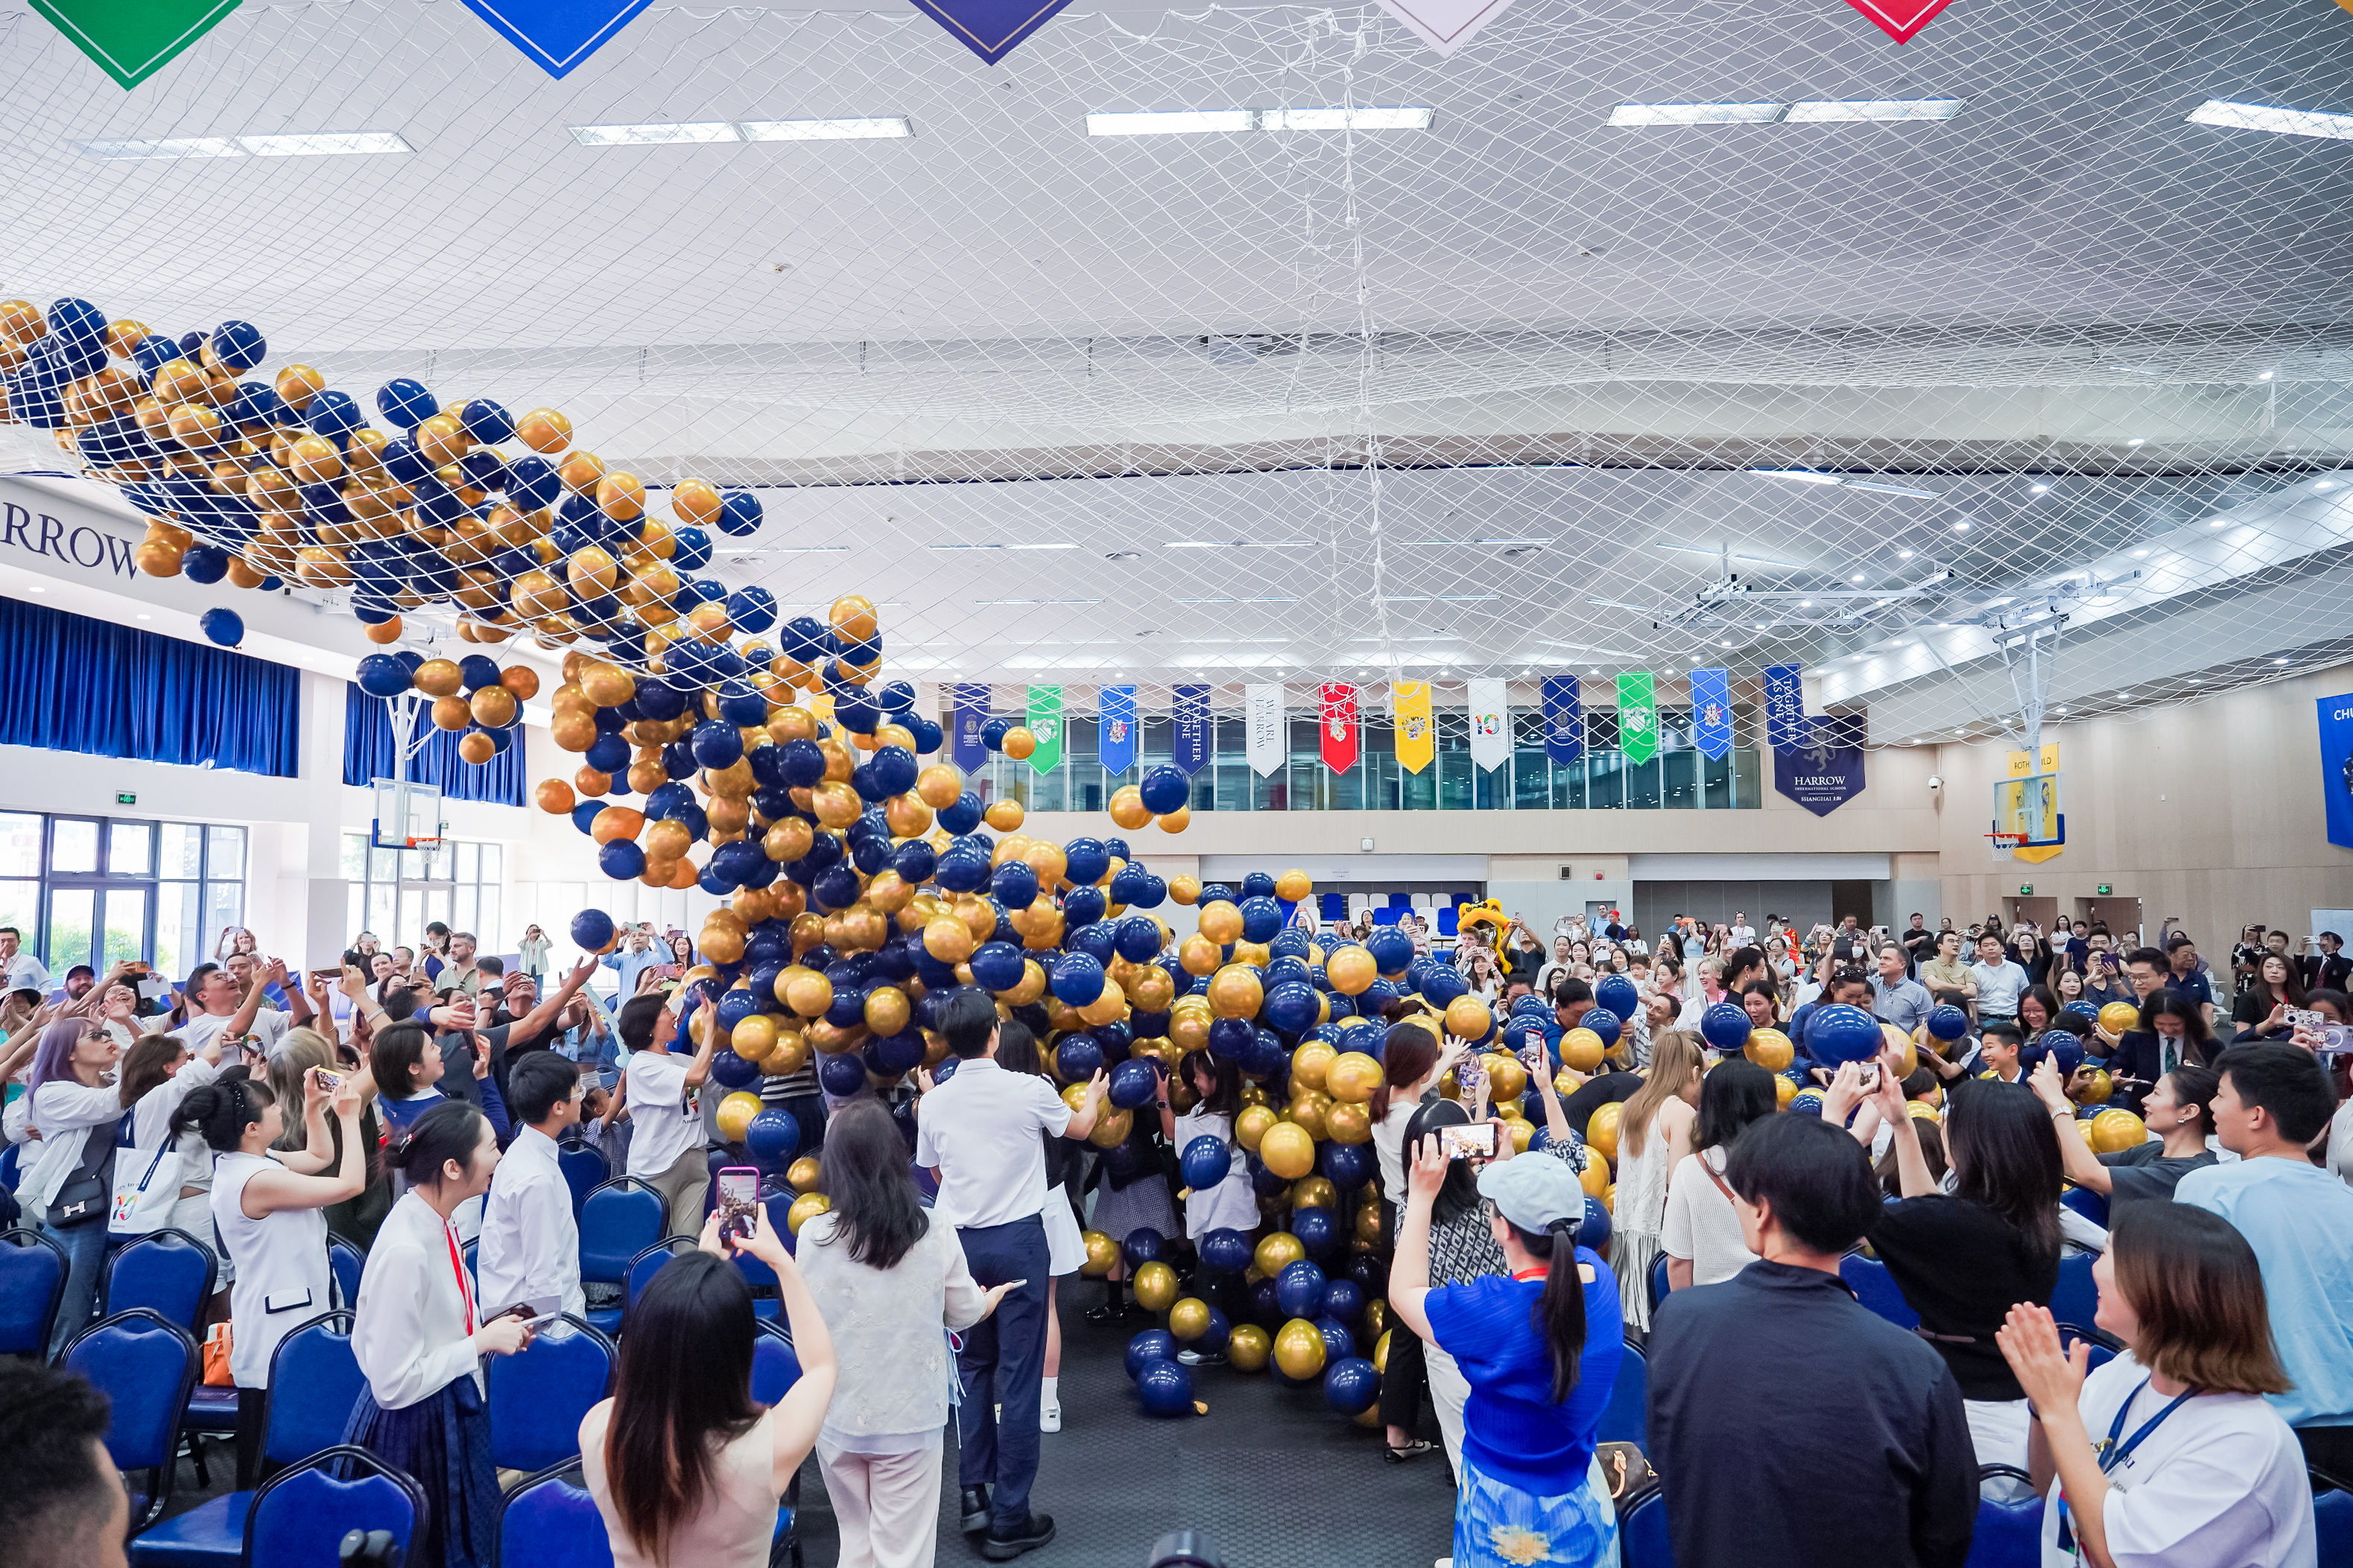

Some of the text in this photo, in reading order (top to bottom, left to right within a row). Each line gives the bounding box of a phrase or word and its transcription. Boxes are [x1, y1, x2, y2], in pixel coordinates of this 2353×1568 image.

[1266, 699, 1275, 743] WE ARE
[1774, 694, 1784, 719] ONE
[1783, 679, 1796, 740] TOGETHER
[1182, 714, 1191, 739] ONE
[1192, 699, 1201, 762] TOGETHER
[1255, 699, 1265, 751] HARROW
[1475, 714, 1499, 735] 10
[1794, 776, 1846, 786] HARROW
